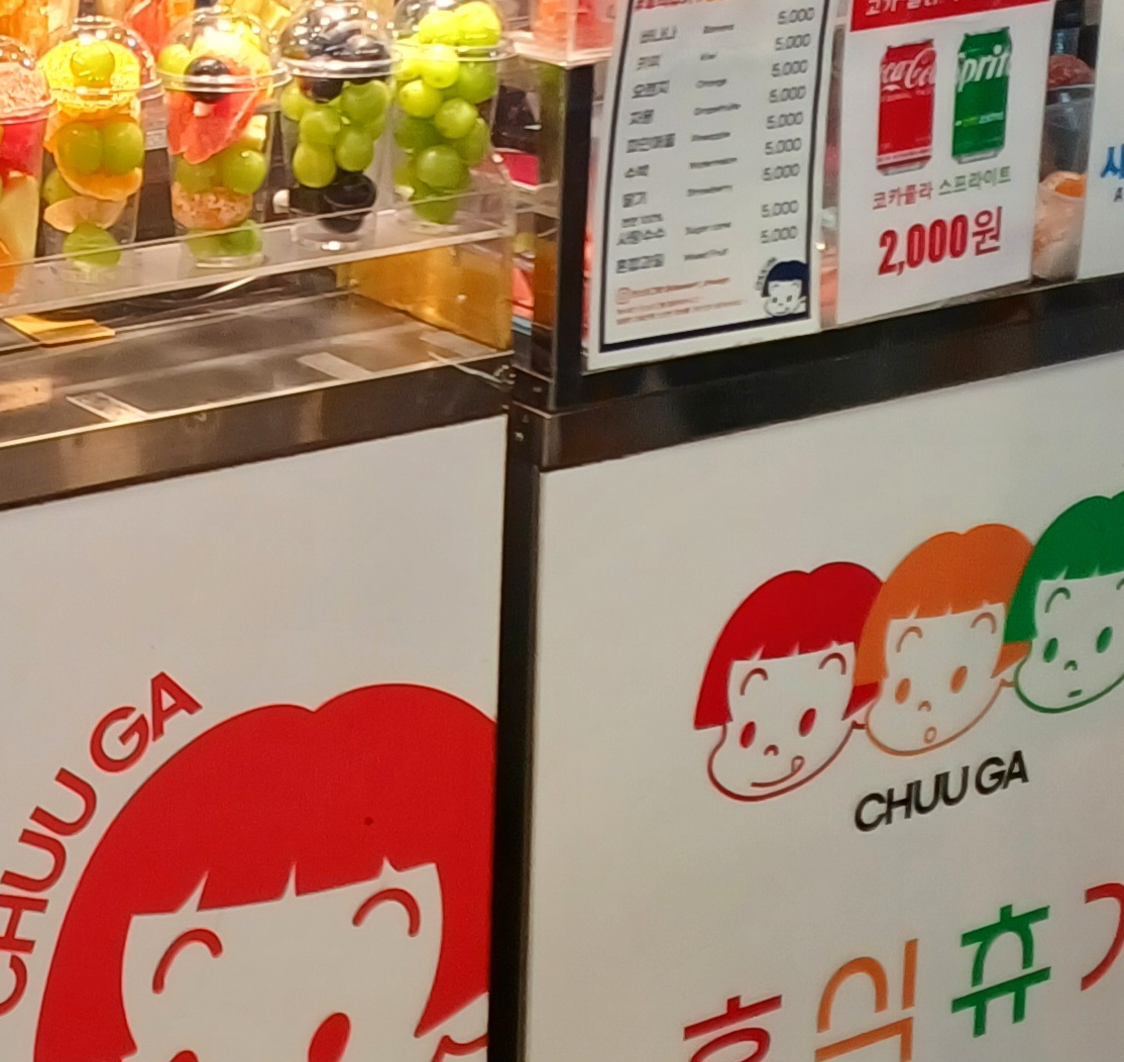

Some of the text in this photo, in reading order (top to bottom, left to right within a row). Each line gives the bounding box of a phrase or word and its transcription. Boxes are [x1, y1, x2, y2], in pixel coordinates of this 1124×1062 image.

[877, 206, 1003, 276] 2,000원
[90, 671, 202, 773] GA
[854, 750, 1029, 832] CHUU GA
